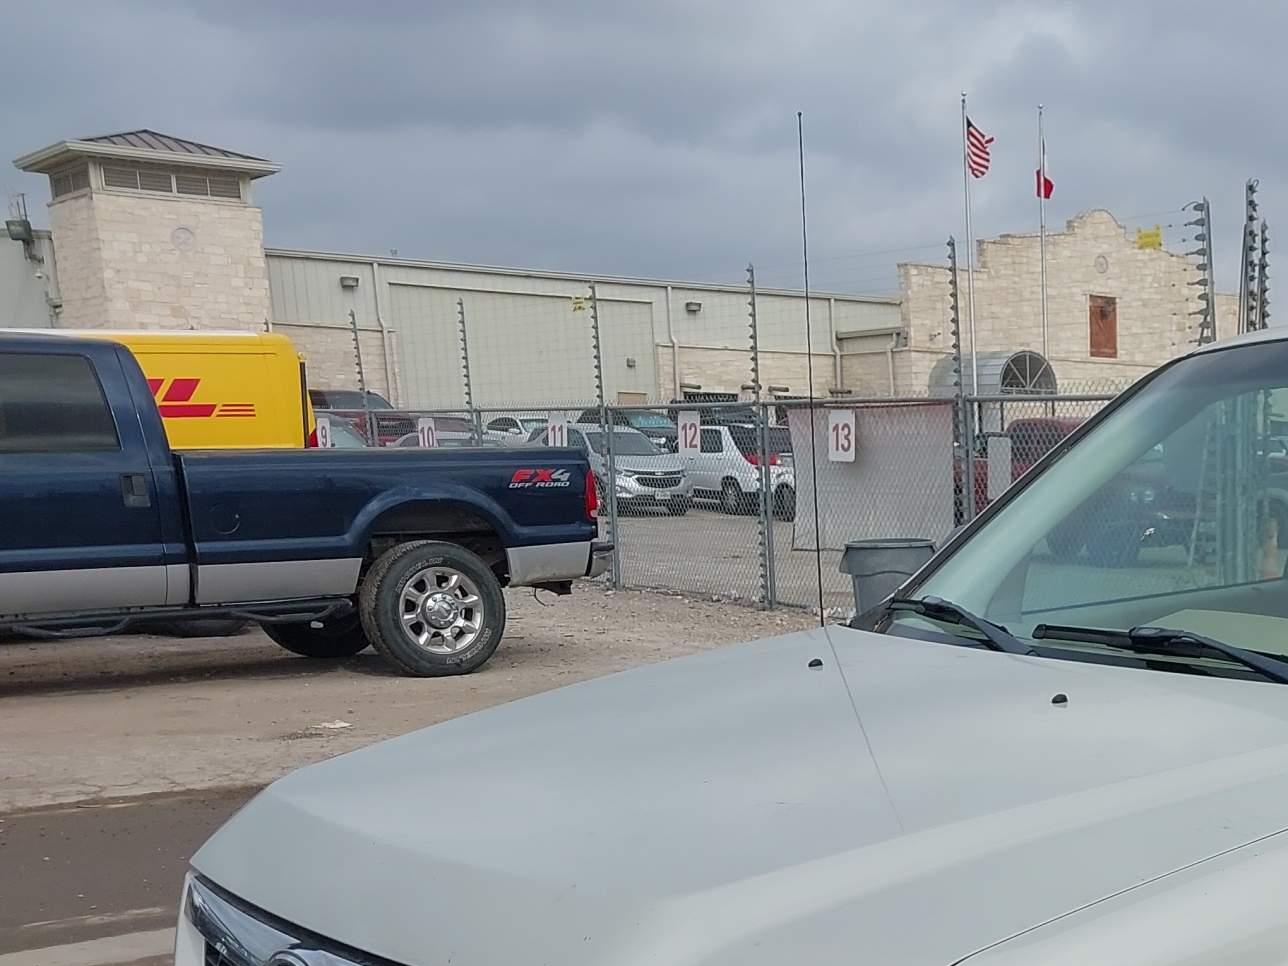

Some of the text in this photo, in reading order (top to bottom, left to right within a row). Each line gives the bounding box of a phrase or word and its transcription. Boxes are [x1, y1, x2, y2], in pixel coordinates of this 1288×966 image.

[320, 425, 328, 448] 9
[419, 426, 435, 448] 10
[550, 425, 564, 447] 11
[680, 422, 698, 449] 12
[832, 424, 851, 453] 13
[508, 481, 534, 489] OFF
[511, 468, 571, 482] FX4
